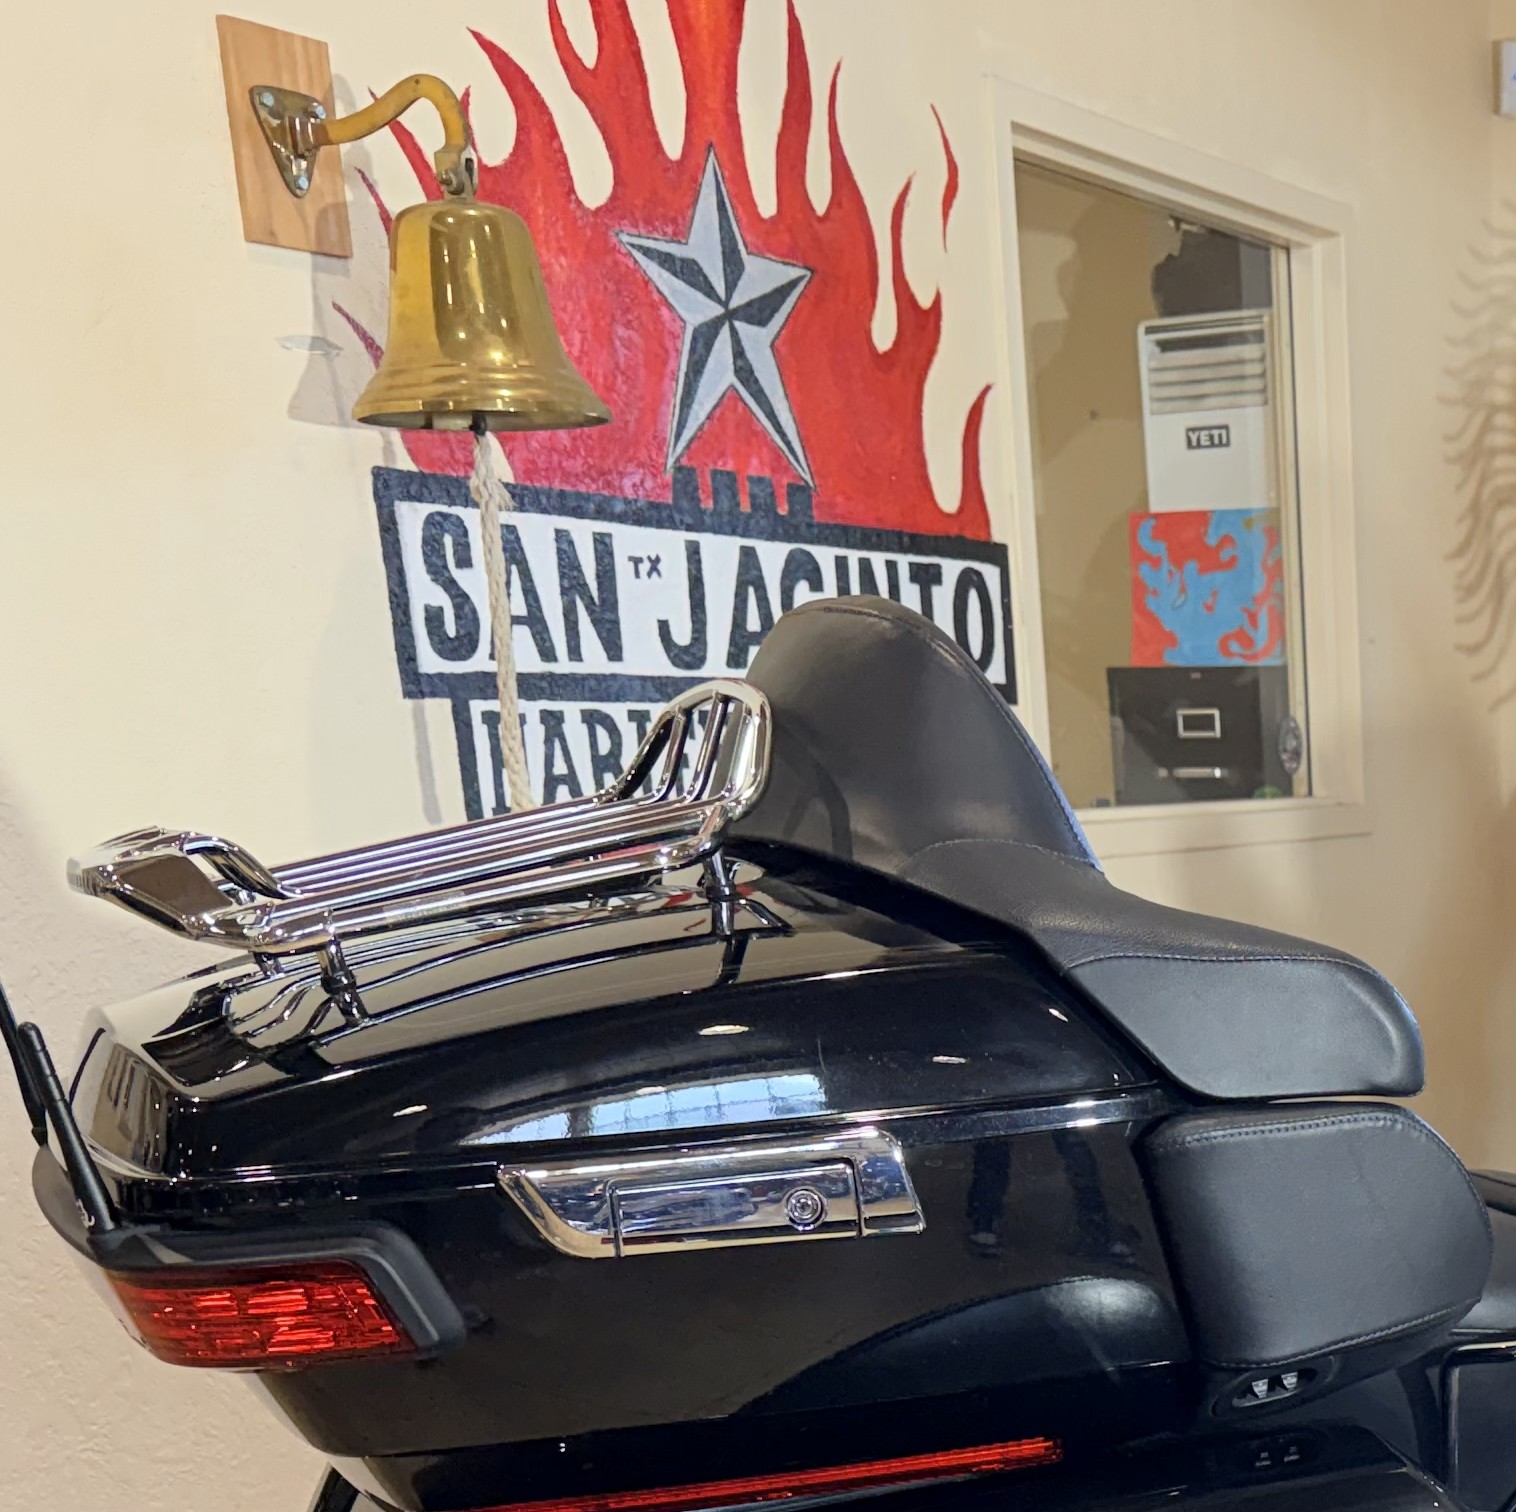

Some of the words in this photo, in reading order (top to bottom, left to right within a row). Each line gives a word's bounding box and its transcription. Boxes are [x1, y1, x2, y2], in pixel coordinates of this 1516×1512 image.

[1187, 429, 1229, 447] YETI
[421, 511, 624, 664] SAN
[628, 554, 663, 580] TX
